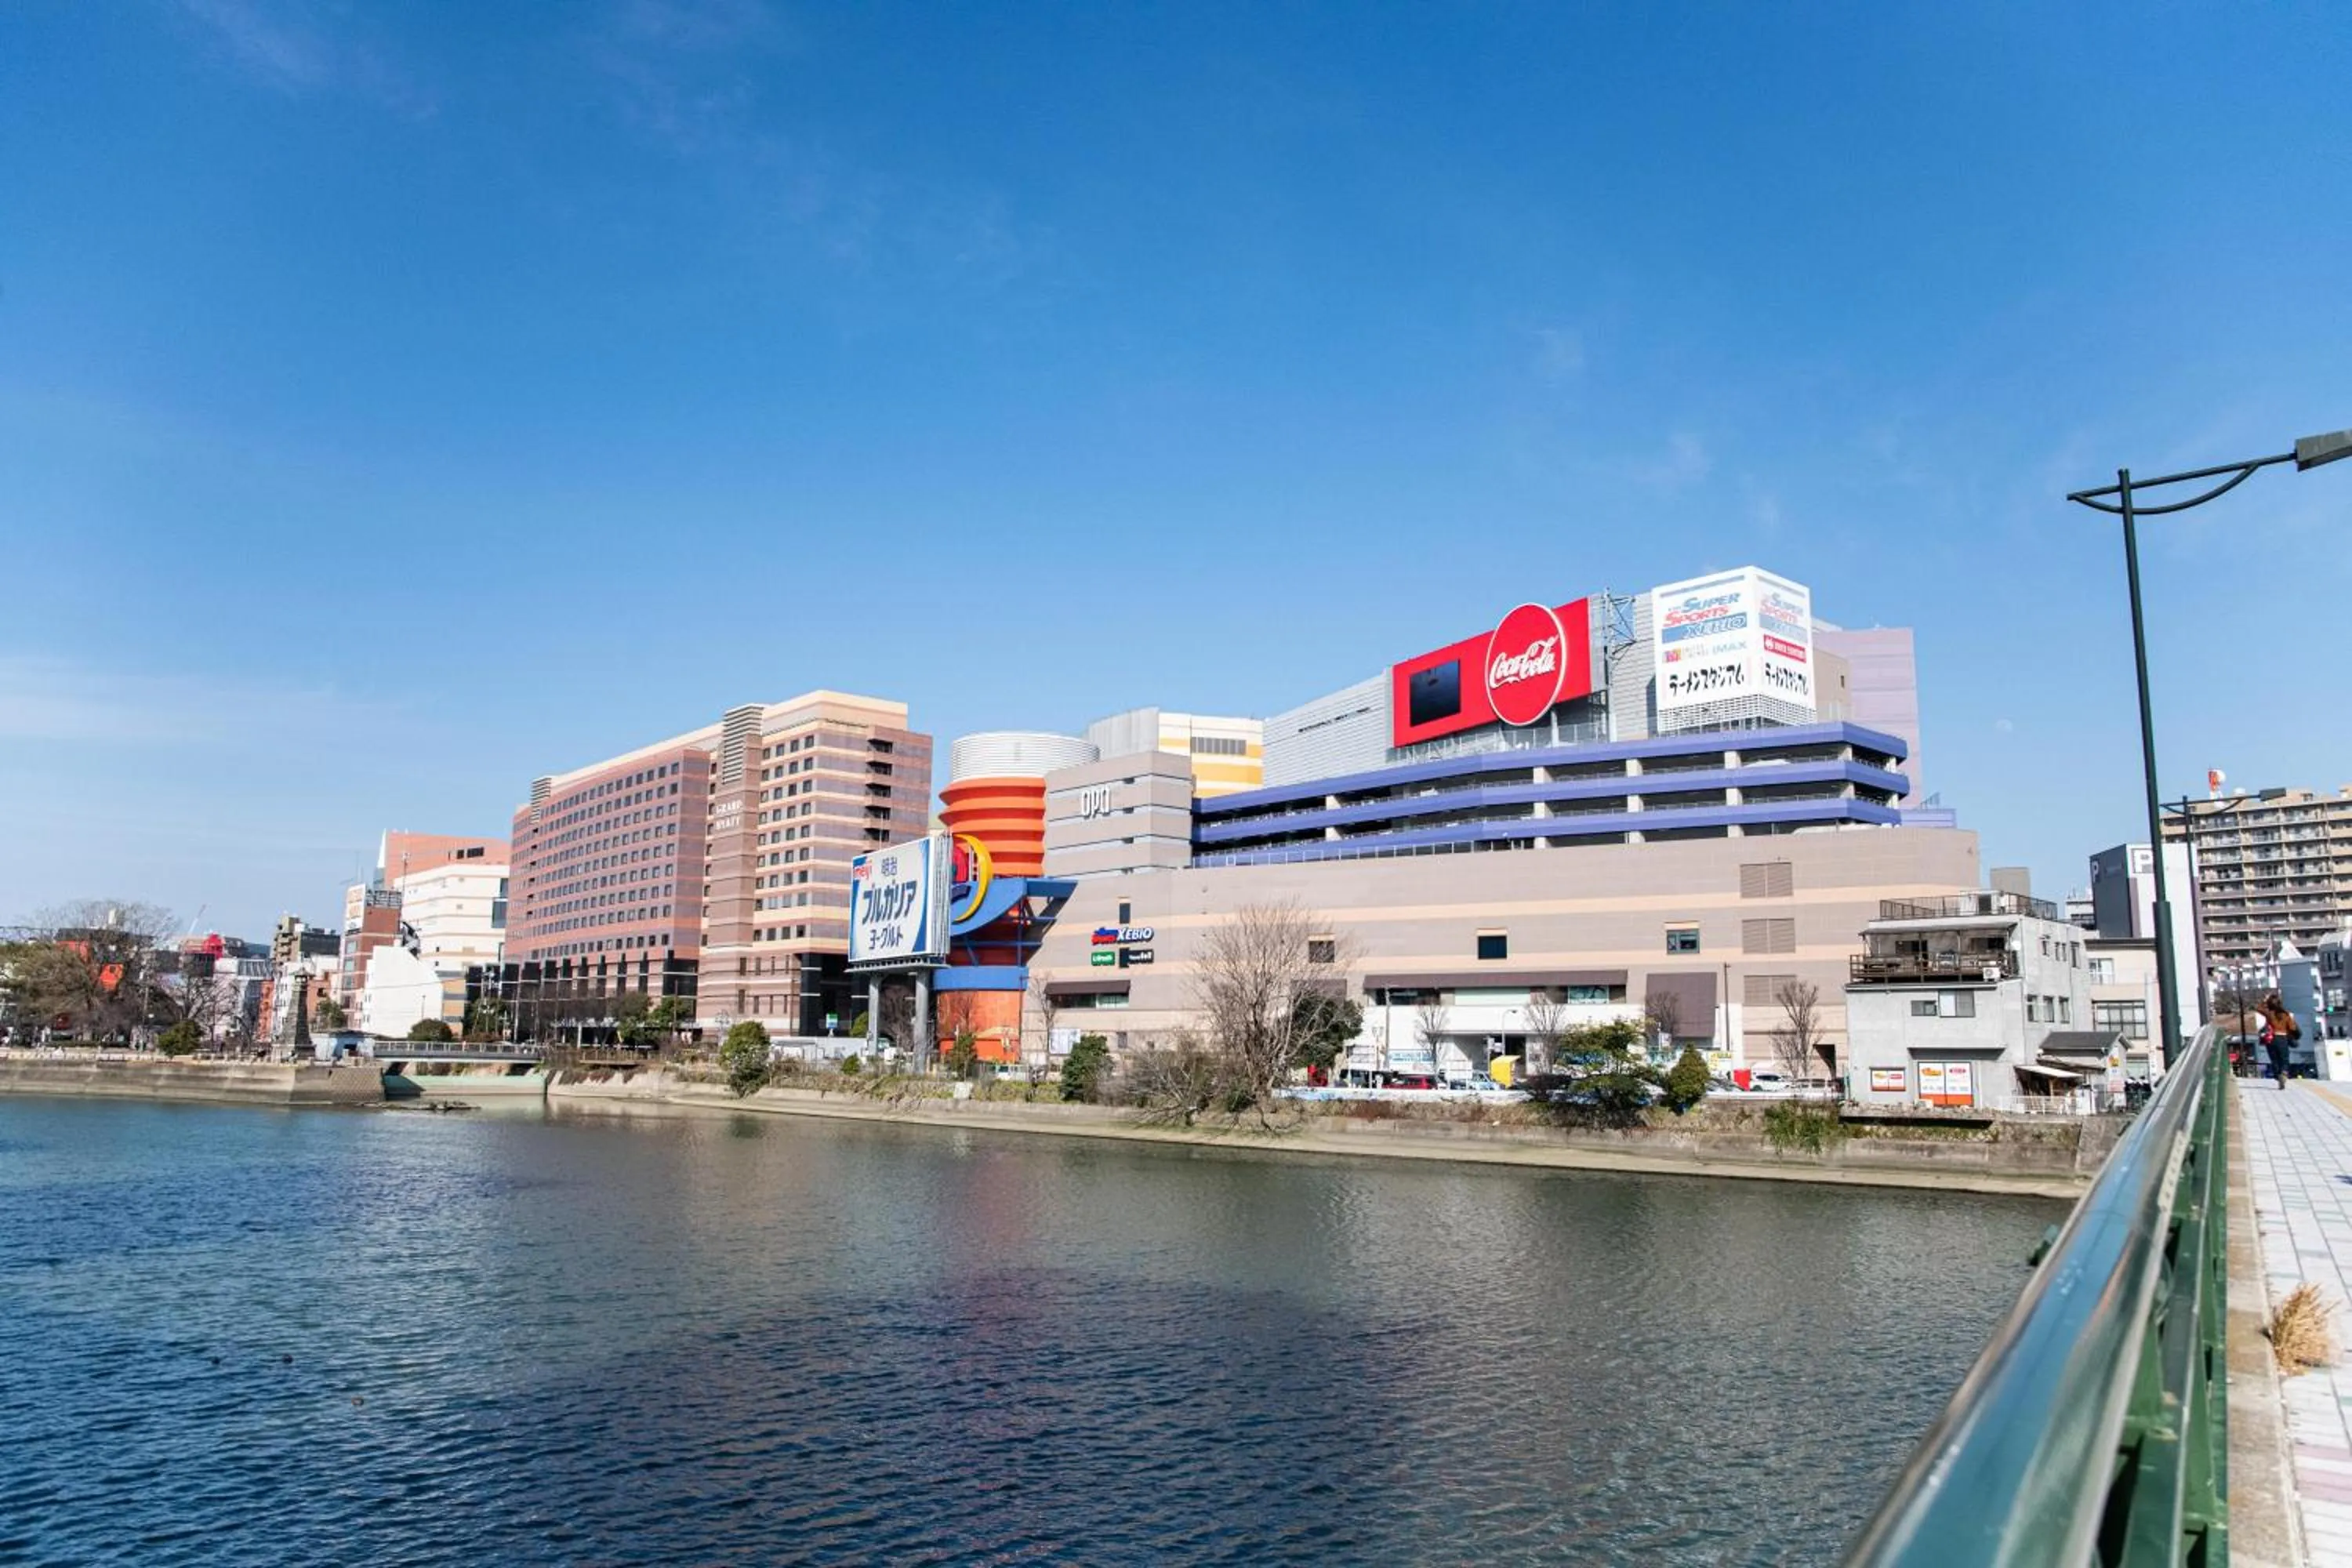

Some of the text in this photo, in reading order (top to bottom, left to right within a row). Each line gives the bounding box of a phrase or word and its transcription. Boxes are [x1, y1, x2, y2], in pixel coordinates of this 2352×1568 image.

[1682, 593, 1740, 613] SUPER
[1663, 605, 1730, 627] SPORTS
[1490, 634, 1559, 688] Coca-Cola
[1669, 662, 1744, 696] ラーメンスタジアム
[881, 855, 898, 877] 明治
[2091, 861, 2100, 884] P
[862, 879, 917, 925] ブルガリア
[869, 924, 903, 950] ヨーグルト
[1116, 927, 1152, 942] XEBIO
